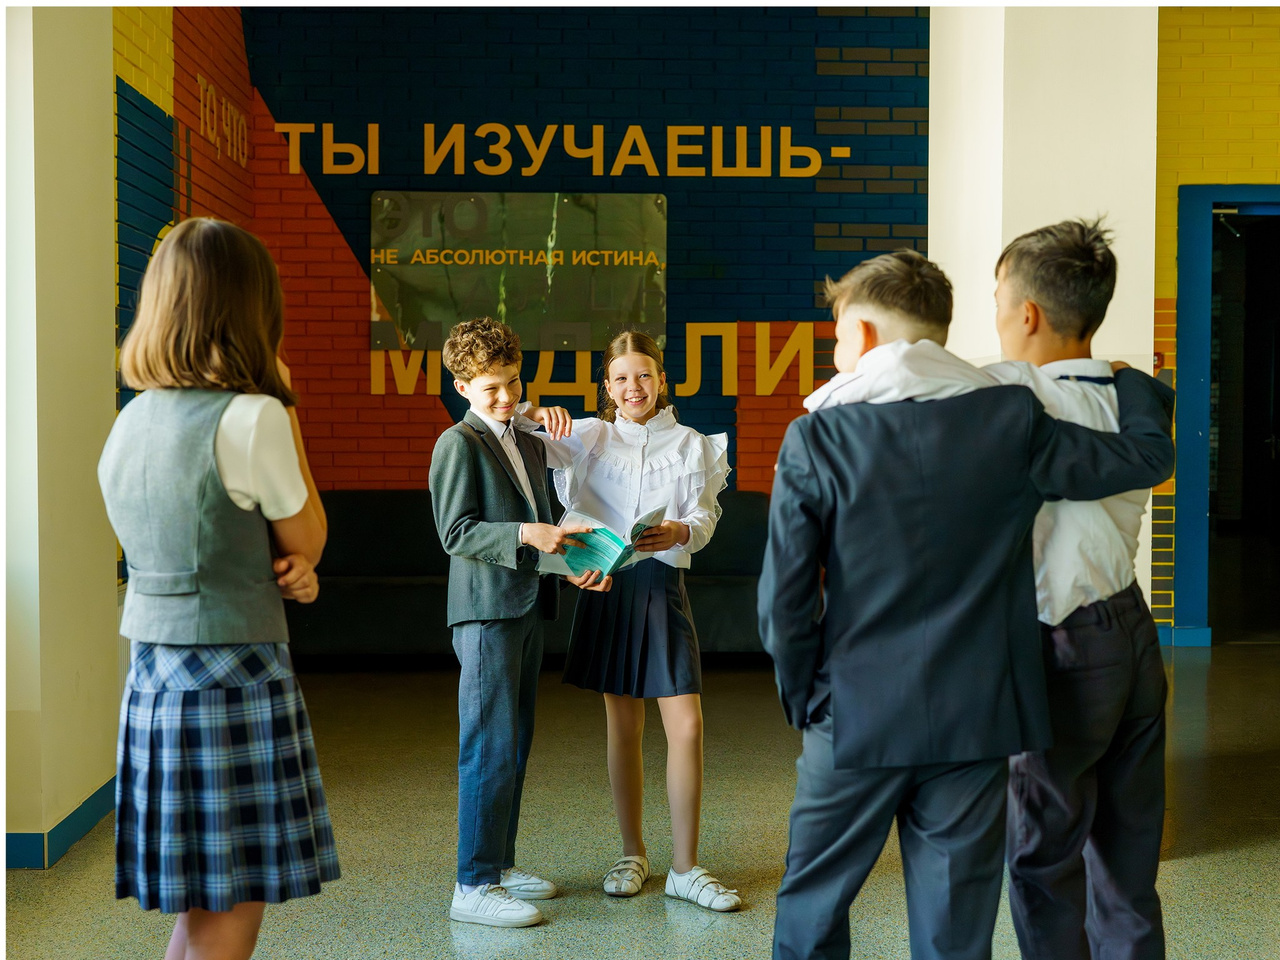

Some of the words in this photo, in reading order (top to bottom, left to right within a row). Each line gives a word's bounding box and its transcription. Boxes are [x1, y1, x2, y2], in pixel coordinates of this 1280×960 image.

[274, 122, 380, 175] ТЫ
[424, 123, 851, 178] ИЗУЧАЕШЬ-
[370, 249, 399, 265] НЕ
[410, 249, 564, 266] АБСОЛЮТНАЯ
[572, 250, 666, 270] ИСТИНА,
[370, 321, 814, 412] МДЛИ
